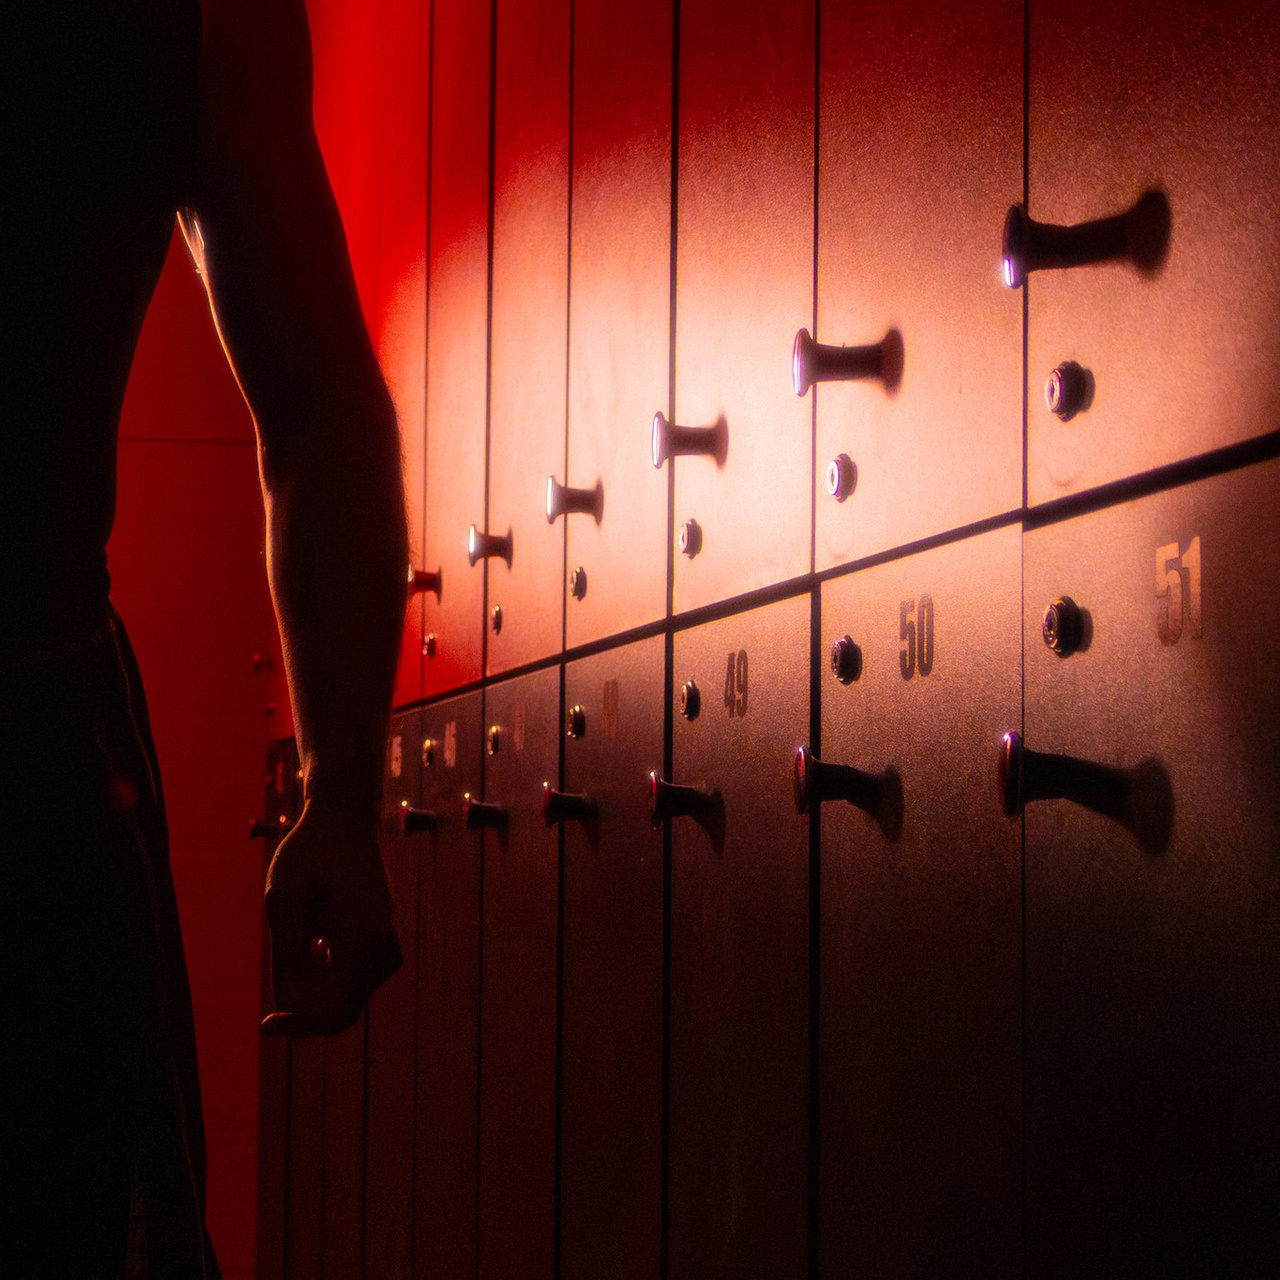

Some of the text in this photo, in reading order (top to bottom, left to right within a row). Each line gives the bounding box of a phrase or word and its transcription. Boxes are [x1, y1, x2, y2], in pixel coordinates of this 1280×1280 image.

[1155, 535, 1202, 647] 51
[900, 592, 934, 681] 50
[724, 649, 748, 718] 49
